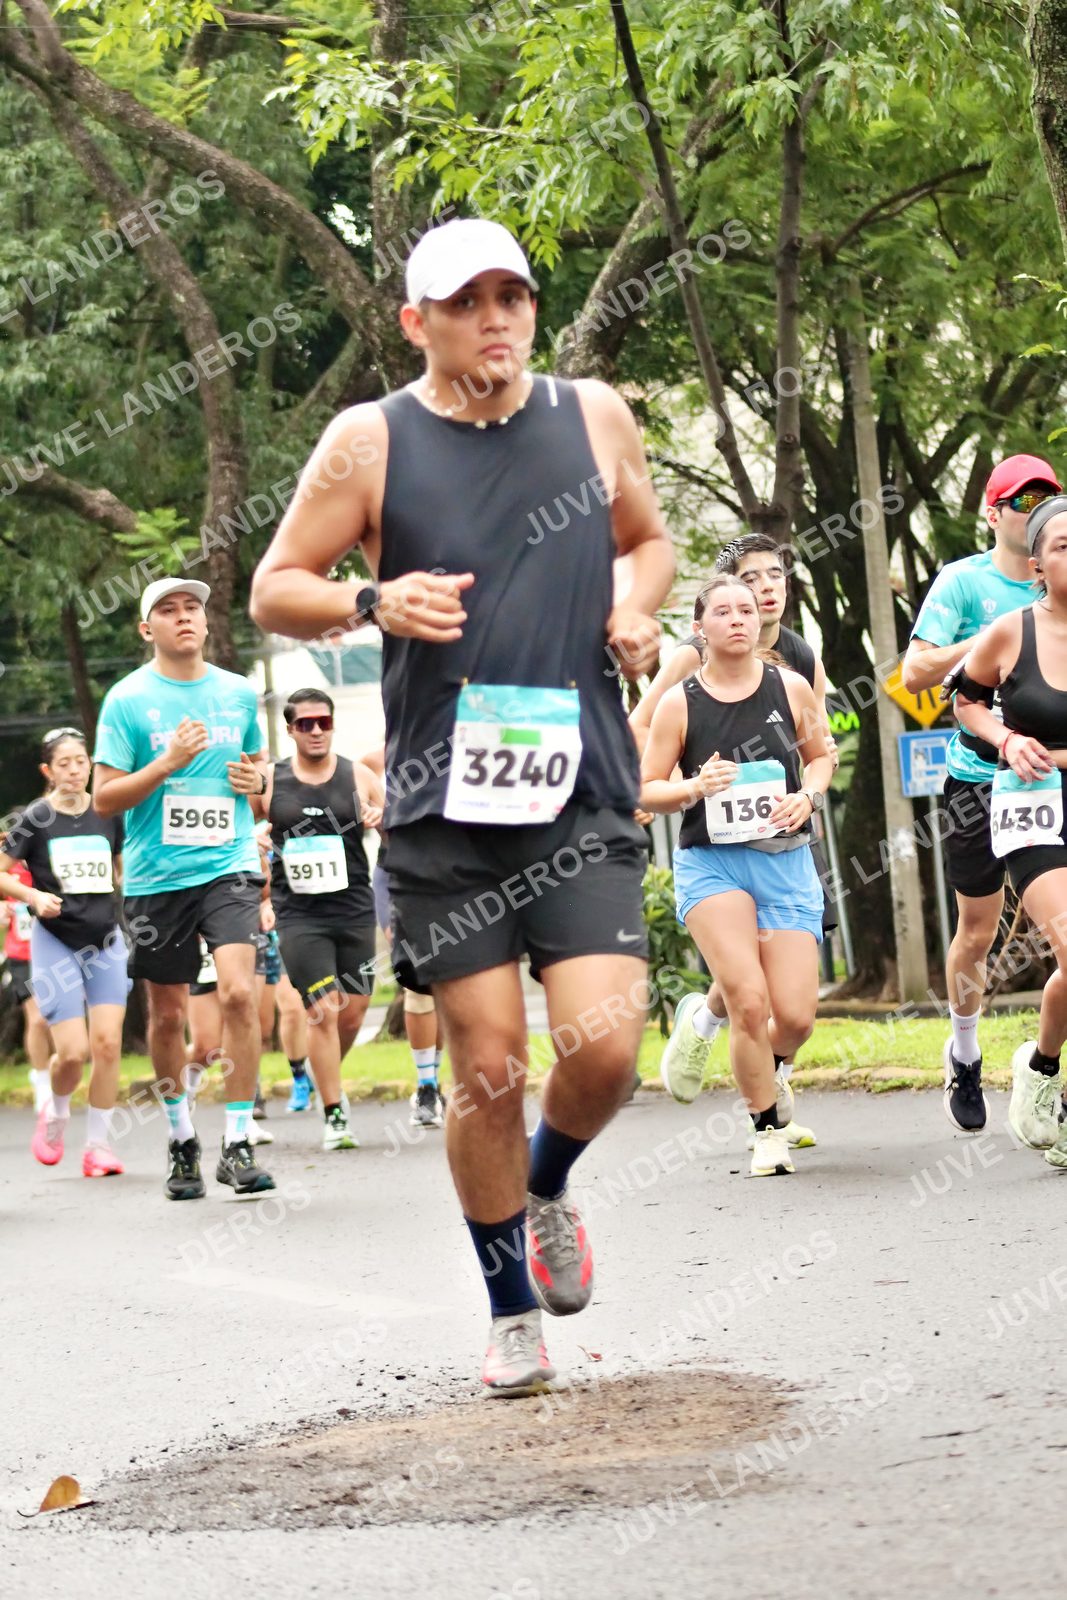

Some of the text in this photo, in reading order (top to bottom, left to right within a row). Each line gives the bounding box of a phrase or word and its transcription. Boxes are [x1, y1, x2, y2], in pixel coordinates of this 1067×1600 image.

[462, 748, 569, 788] 3240
[169, 808, 229, 829] 5965
[721, 796, 773, 824] 136
[59, 861, 107, 880] 3320
[290, 861, 338, 880] 3911
